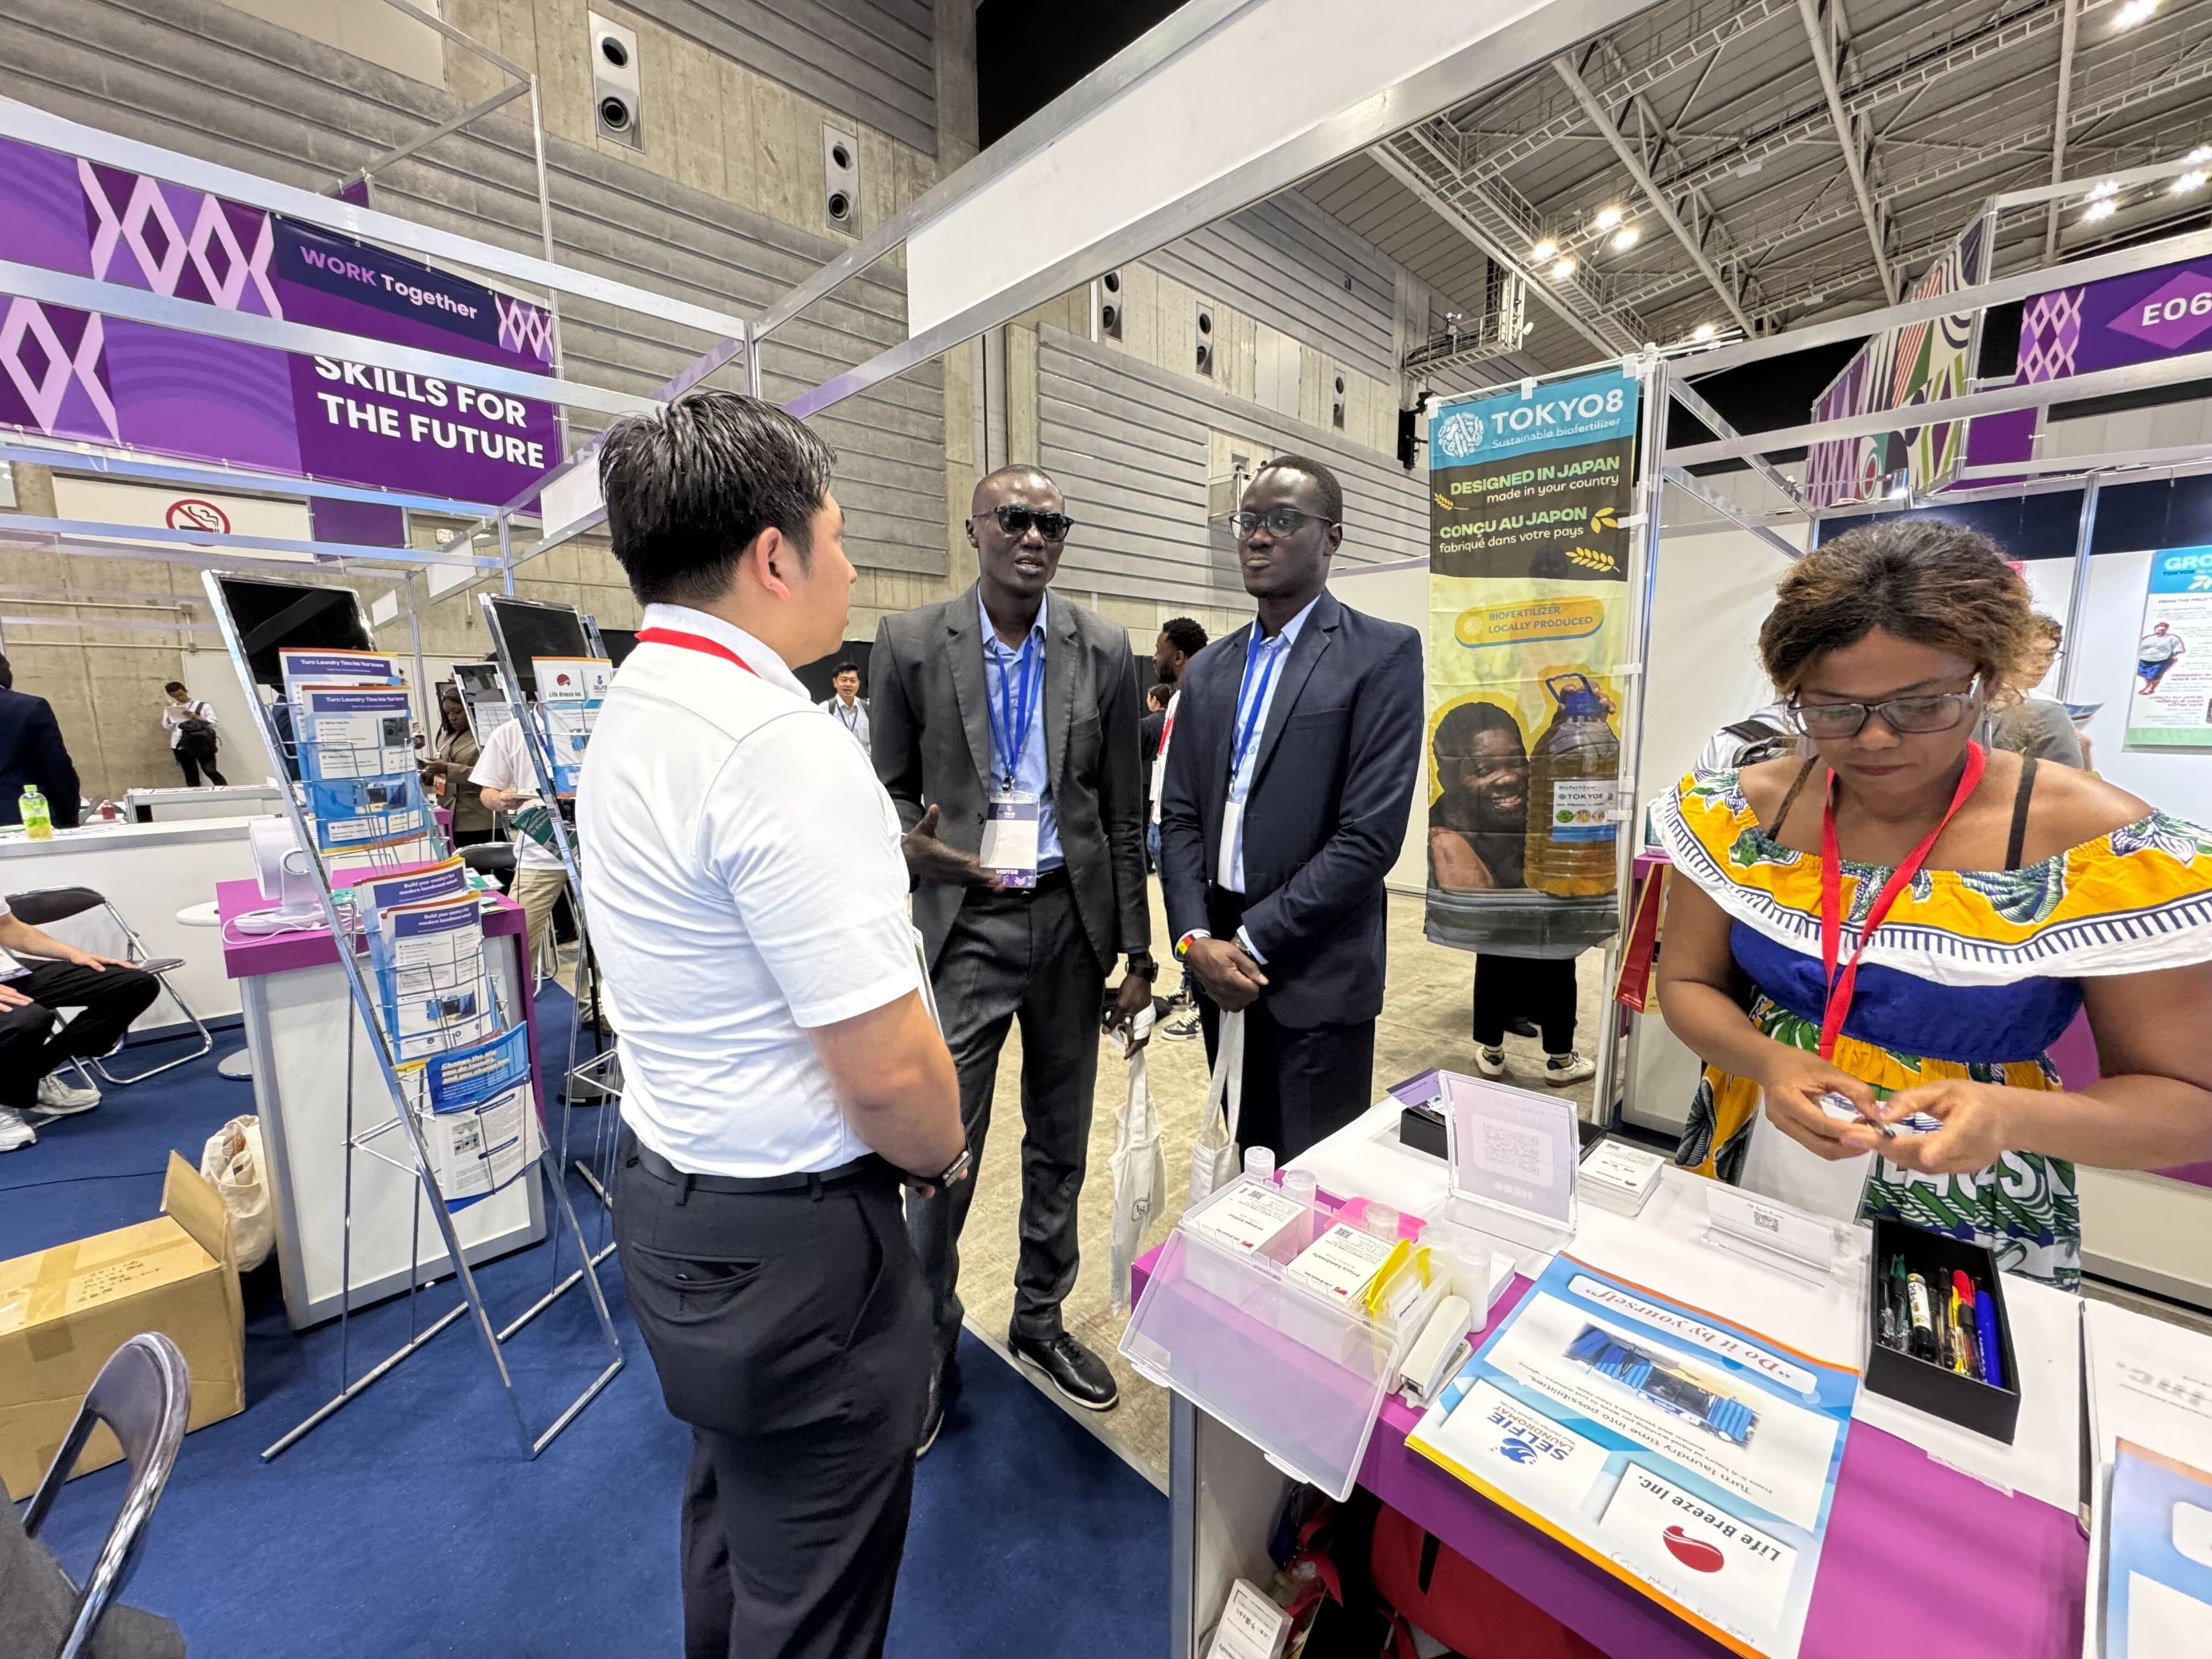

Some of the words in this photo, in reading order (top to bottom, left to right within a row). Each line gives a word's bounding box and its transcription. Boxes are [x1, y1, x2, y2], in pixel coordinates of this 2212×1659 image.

[300, 246, 376, 286] WORK
[381, 274, 477, 320] Together
[314, 355, 448, 408] SKILLS
[457, 383, 527, 428] FOR
[1491, 389, 1624, 434] TOKYO8
[318, 392, 400, 438] THE
[411, 414, 544, 469] FUTURE
[1493, 429, 1554, 449] Sustainable
[1556, 417, 1621, 436] biofertilizer
[1450, 469, 1534, 496] DESIGNED
[1537, 467, 1555, 480] IN
[1558, 456, 1620, 478] JAPAN
[1487, 489, 1521, 503] made
[1524, 486, 1535, 496] in
[1538, 484, 1566, 497] your
[1569, 475, 1619, 491] country
[1440, 520, 1497, 538] CONÇU
[1499, 516, 1524, 531] AU
[1526, 507, 1587, 525] JAPON
[1440, 536, 1485, 554] fabriqué
[1488, 533, 1516, 547] dans
[1520, 529, 1551, 541] votre
[1554, 527, 1584, 540] pays
[1488, 606, 1562, 620] BIOFERTILIZER
[1488, 622, 1530, 634] LOCALLY
[1533, 615, 1593, 629] PRODUCED
[441, 1059, 471, 1070] Change
[1688, 1323, 1717, 1343] by
[1720, 1338, 1738, 1351] it
[1529, 1375, 1599, 1414] possibilities.
[1487, 1412, 1570, 1460] SELFIE
[1493, 1406, 1574, 1452] LAUNDROMAT
[1603, 1414, 1626, 1429] into
[1630, 1429, 1658, 1445] time
[1664, 1445, 1716, 1475] laundry
[1639, 1476, 1669, 1499] Inc.
[1721, 1474, 1751, 1494] Turn
[1672, 1497, 1737, 1537] Breeze
[1741, 1534, 1781, 1561] Life
